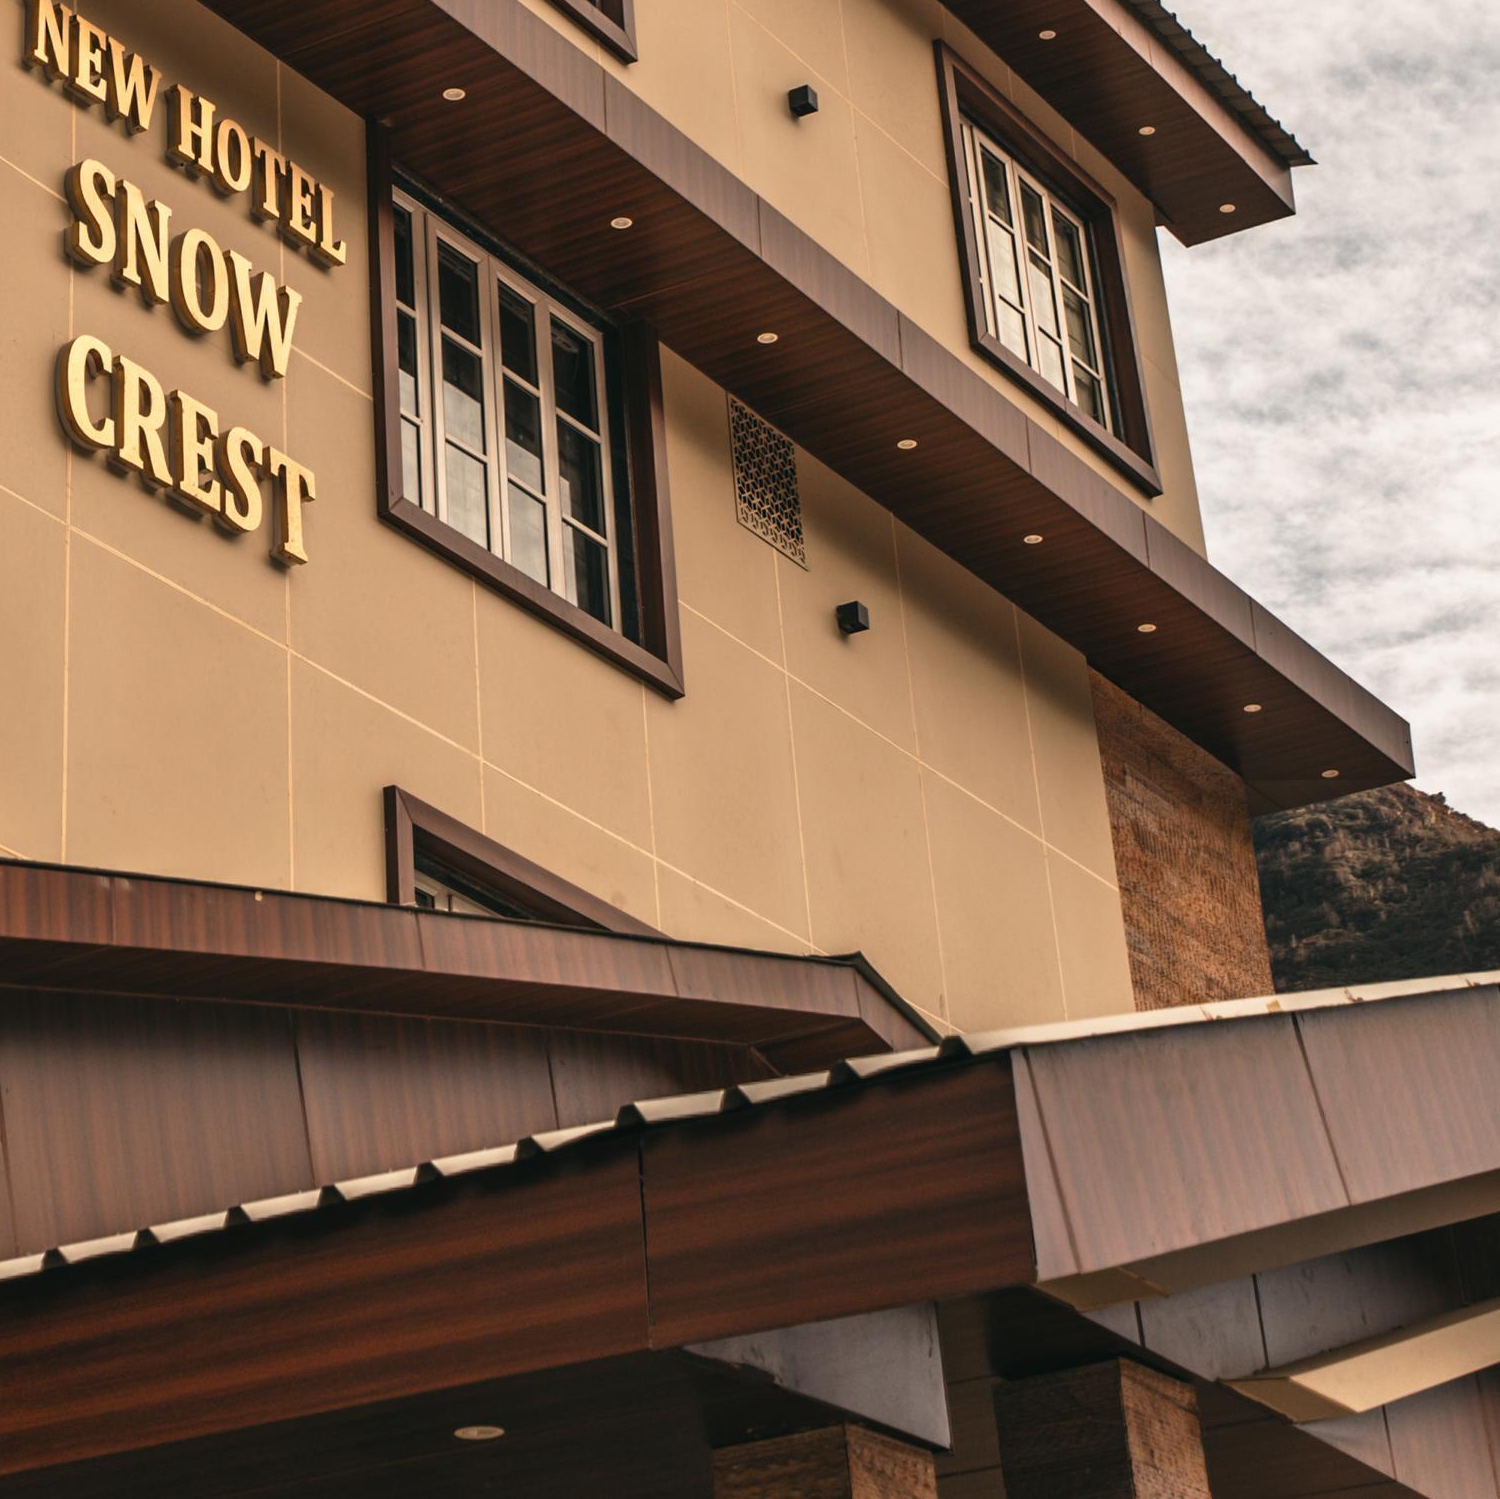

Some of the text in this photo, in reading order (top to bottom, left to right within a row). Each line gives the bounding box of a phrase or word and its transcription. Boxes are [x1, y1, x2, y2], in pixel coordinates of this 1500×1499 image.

[68, 158, 303, 380] SNOW
[167, 83, 346, 267] HOTEL
[57, 334, 315, 566] CREST
